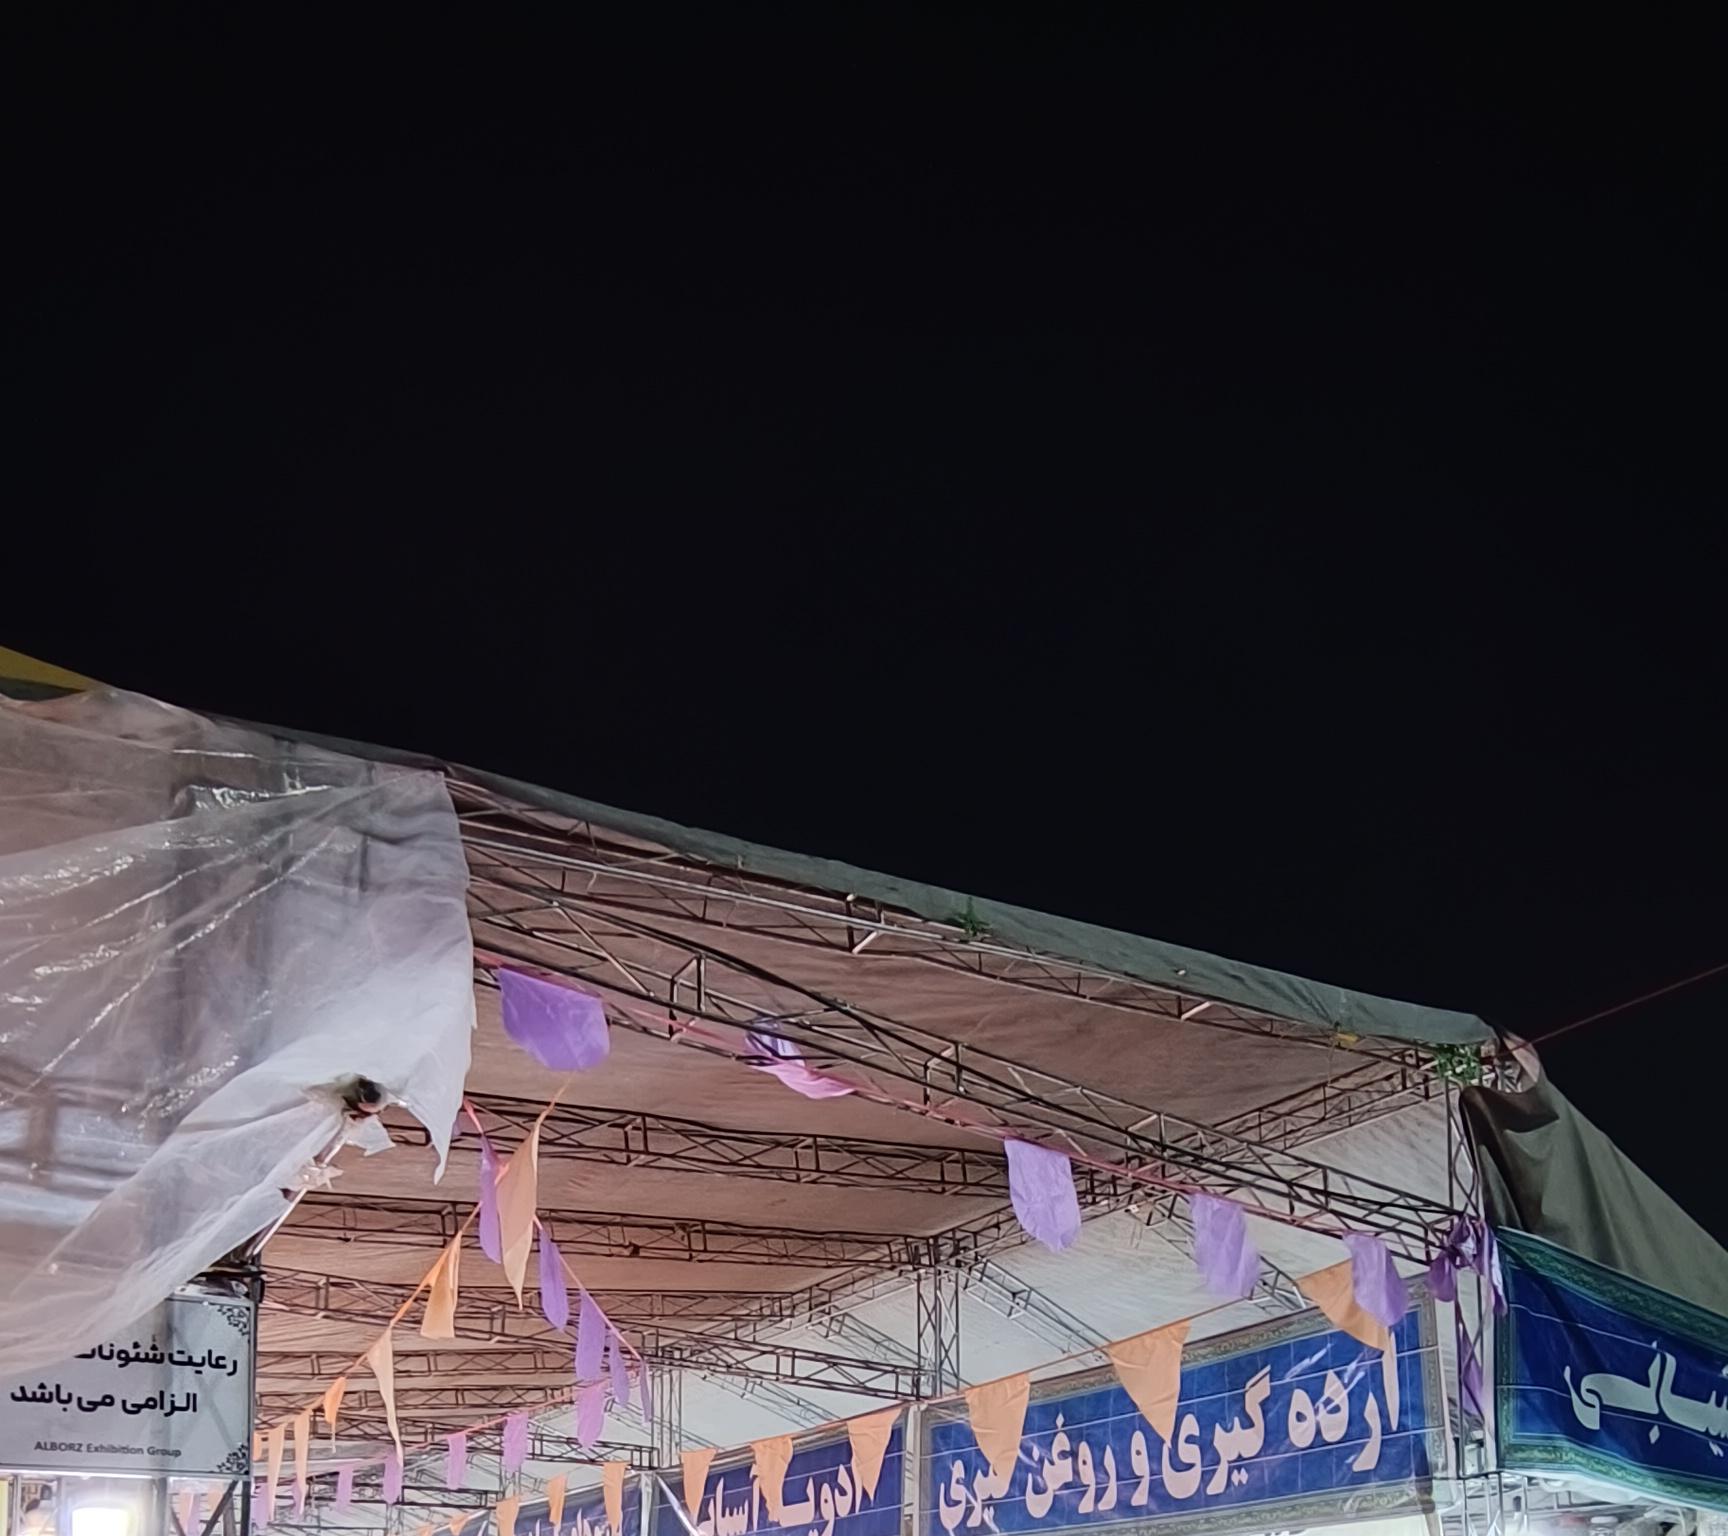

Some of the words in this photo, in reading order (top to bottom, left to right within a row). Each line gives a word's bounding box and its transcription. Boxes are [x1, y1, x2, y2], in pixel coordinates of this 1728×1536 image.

[169, 1349, 238, 1376] رعایت
[10, 1382, 73, 1413] باشد
[77, 1391, 115, 1413] می
[121, 1390, 198, 1417] الزامی
[1288, 1332, 1400, 1473] ارده
[1161, 1364, 1272, 1500] گیری
[34, 1441, 83, 1453] ALBORZ
[86, 1443, 144, 1455] Exhibition
[146, 1446, 182, 1458] Group
[1025, 1412, 1118, 1519] روغن
[1130, 1429, 1150, 1507] و
